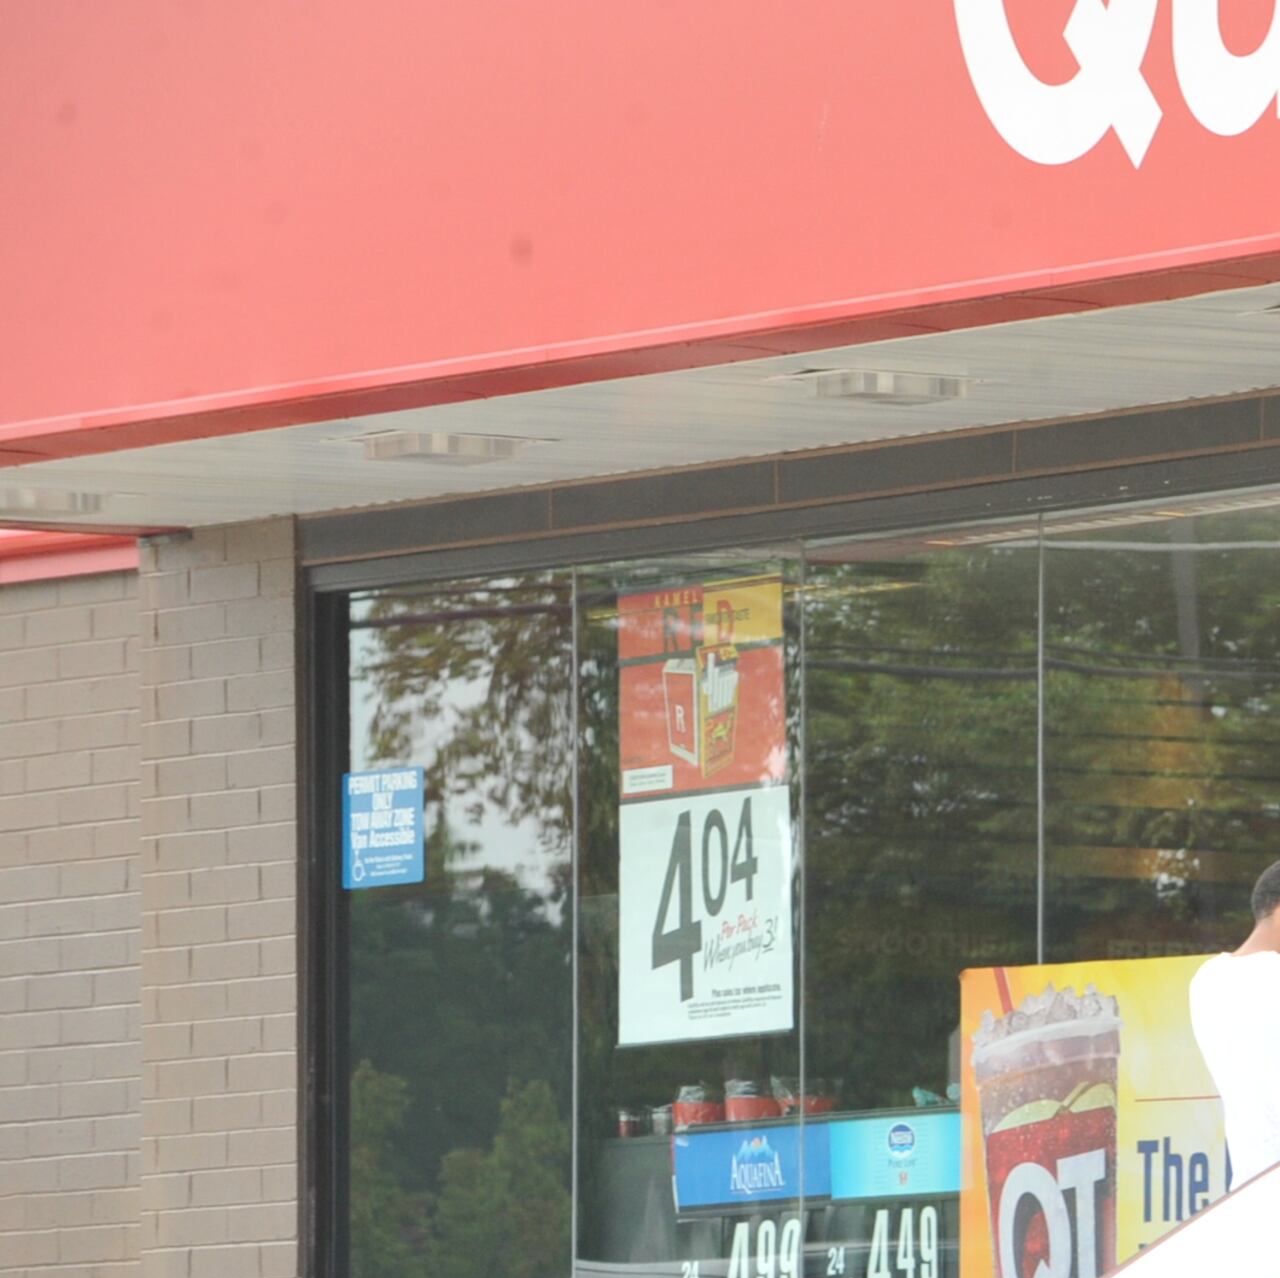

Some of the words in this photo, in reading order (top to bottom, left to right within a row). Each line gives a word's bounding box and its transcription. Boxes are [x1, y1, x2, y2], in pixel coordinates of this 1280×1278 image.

[349, 774, 381, 796] PERMIT
[382, 770, 417, 792] PARKING
[730, 1151, 785, 1195] AQUAFINA
[1137, 1136, 1210, 1223] The
[827, 1246, 845, 1276] 24
